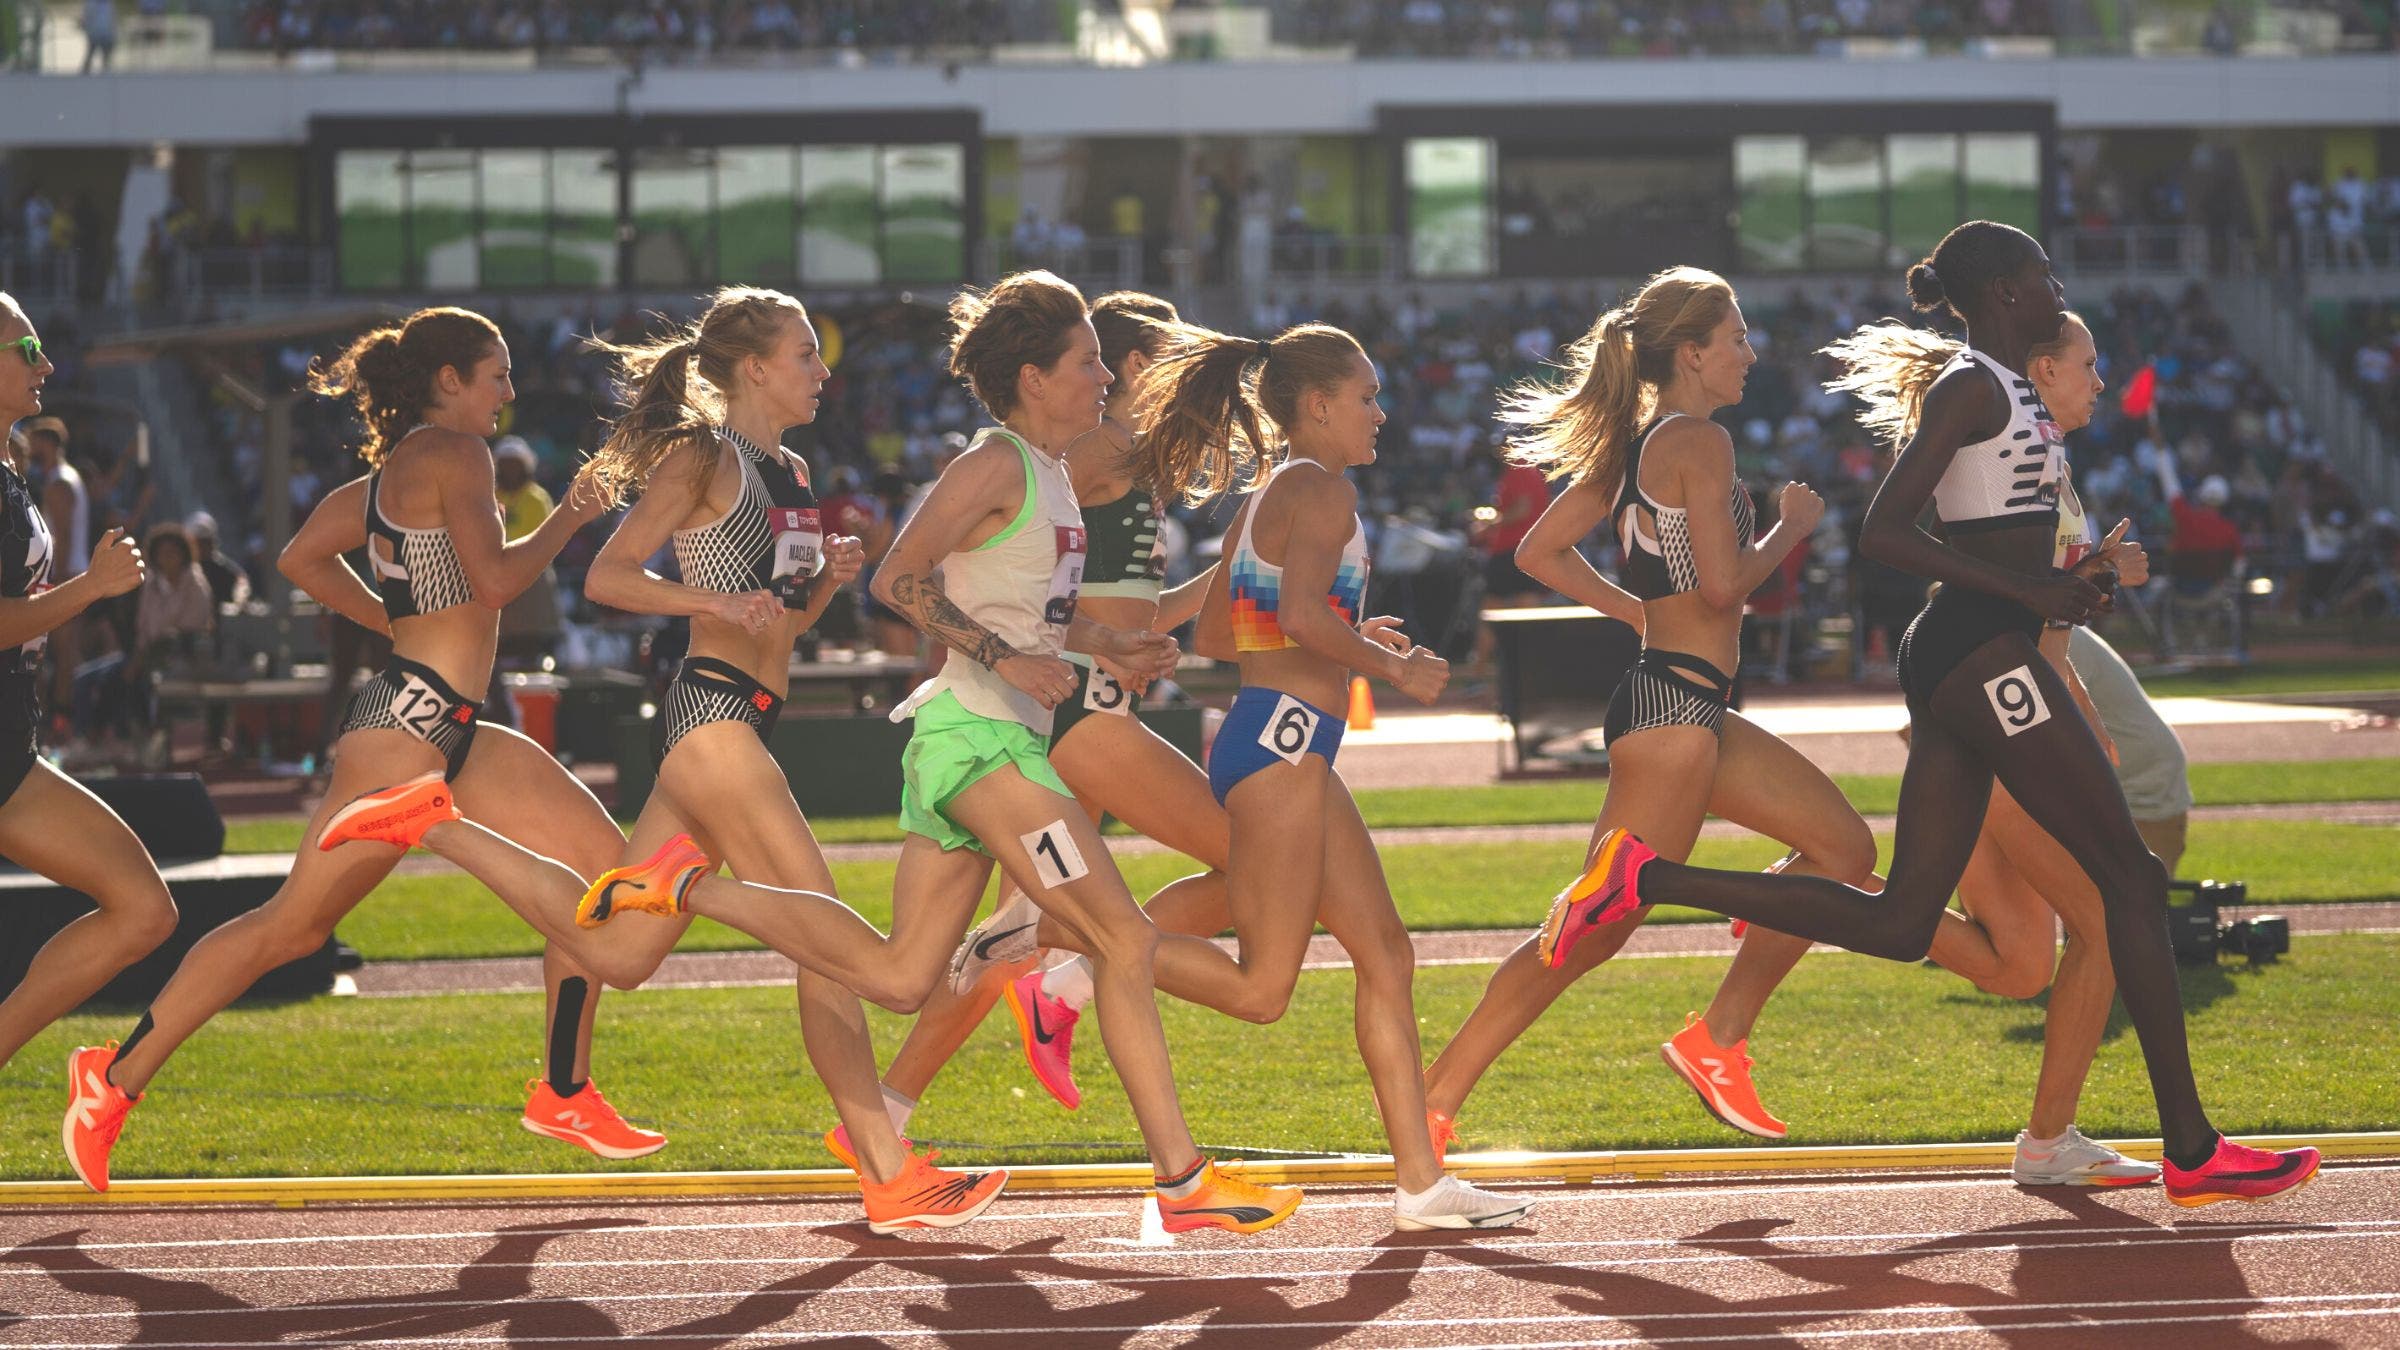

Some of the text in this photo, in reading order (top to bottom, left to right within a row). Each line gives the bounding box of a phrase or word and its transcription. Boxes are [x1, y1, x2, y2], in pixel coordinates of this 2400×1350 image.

[400, 688, 441, 736] 12
[1996, 678, 2036, 726] 9
[1274, 707, 1309, 753] 6
[1036, 831, 1070, 878] 1
